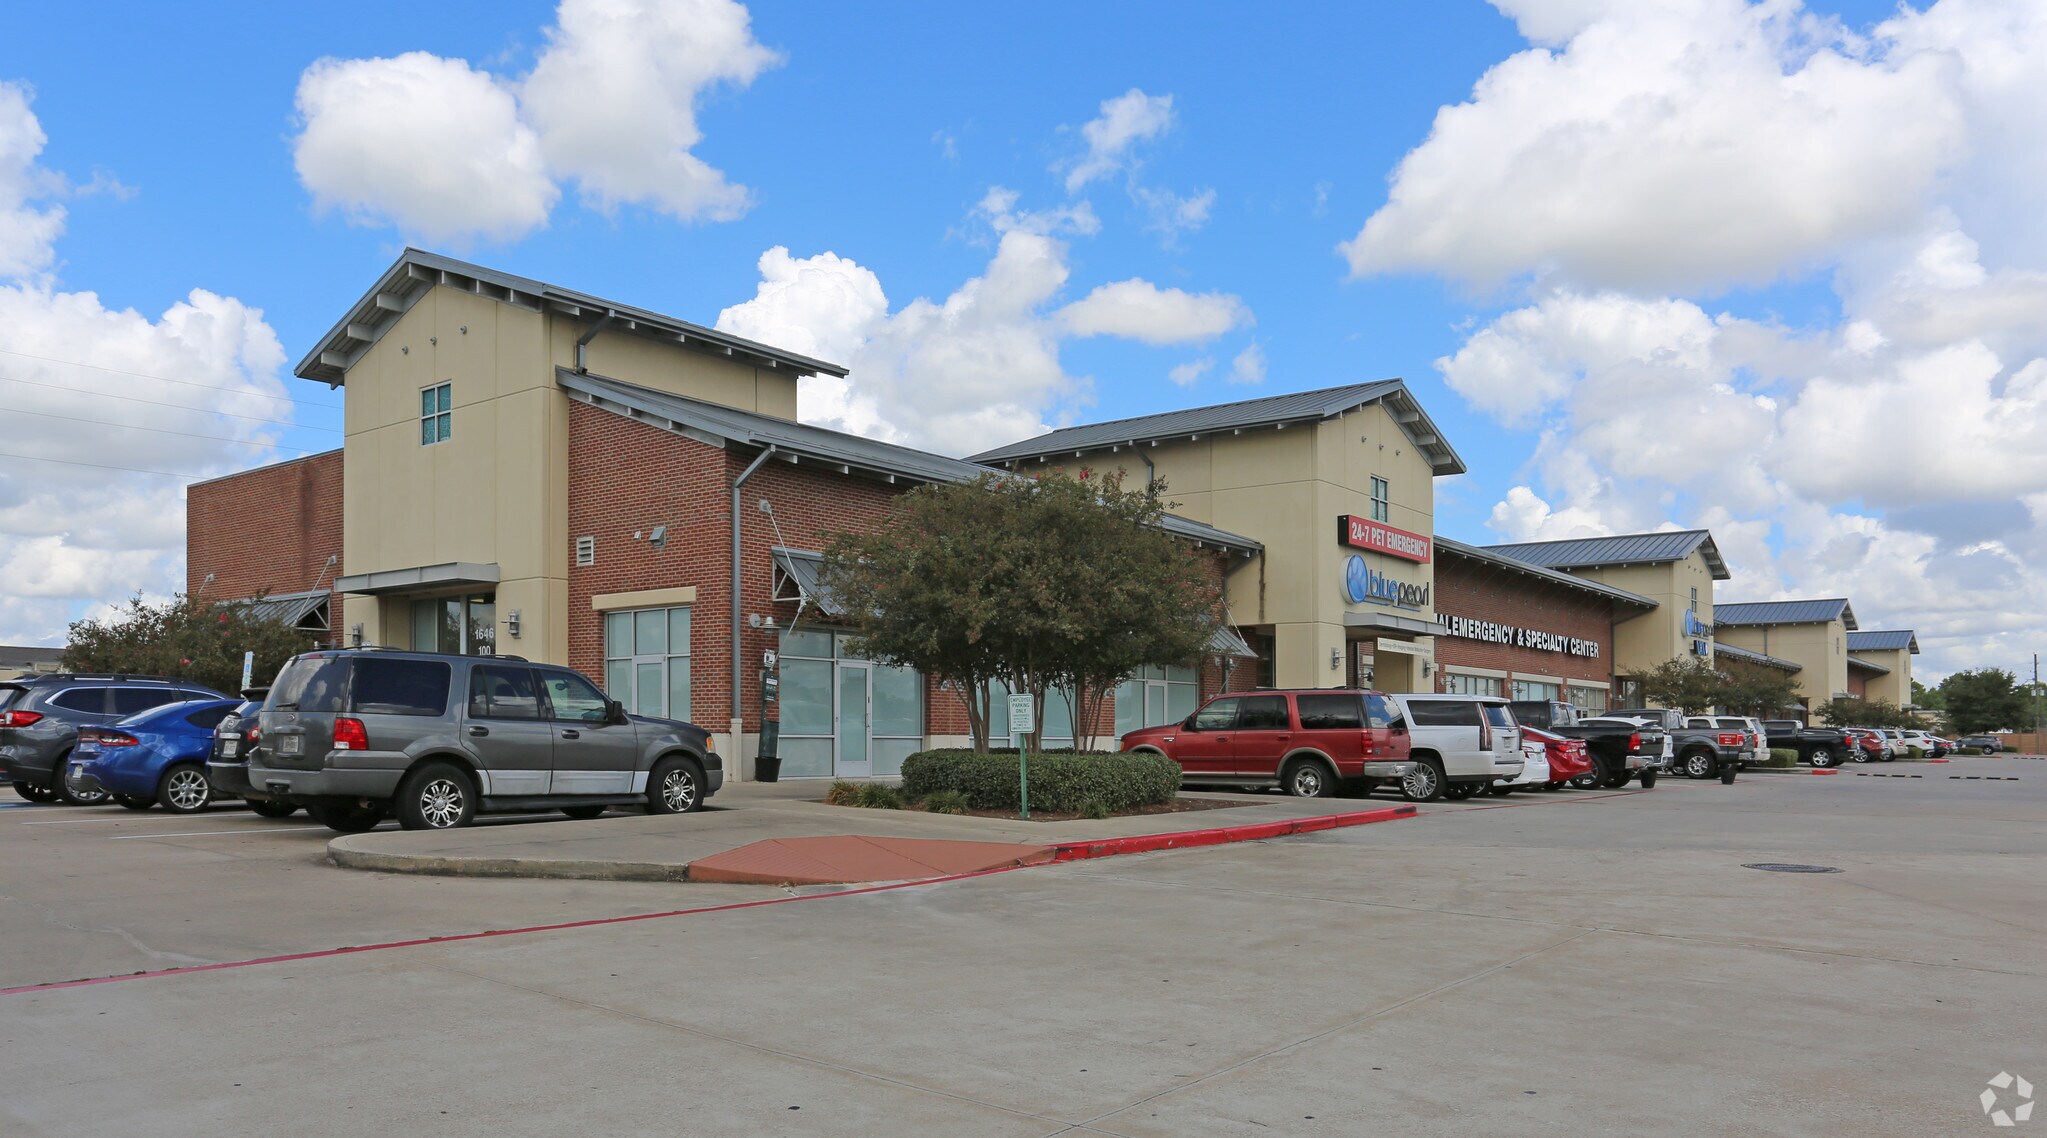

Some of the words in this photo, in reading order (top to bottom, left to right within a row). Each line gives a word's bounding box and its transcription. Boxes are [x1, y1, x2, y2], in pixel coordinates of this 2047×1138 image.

[1351, 522, 1370, 543] 24-7
[1371, 527, 1386, 547] PET
[1387, 531, 1428, 558] EMERGENCY
[475, 627, 494, 640] 1646
[1452, 616, 1514, 645] EMERGENCY
[1517, 627, 1525, 647] &
[1525, 629, 1569, 653] SPECIALTY
[1570, 637, 1599, 658] CENTER
[478, 645, 491, 656] 100
